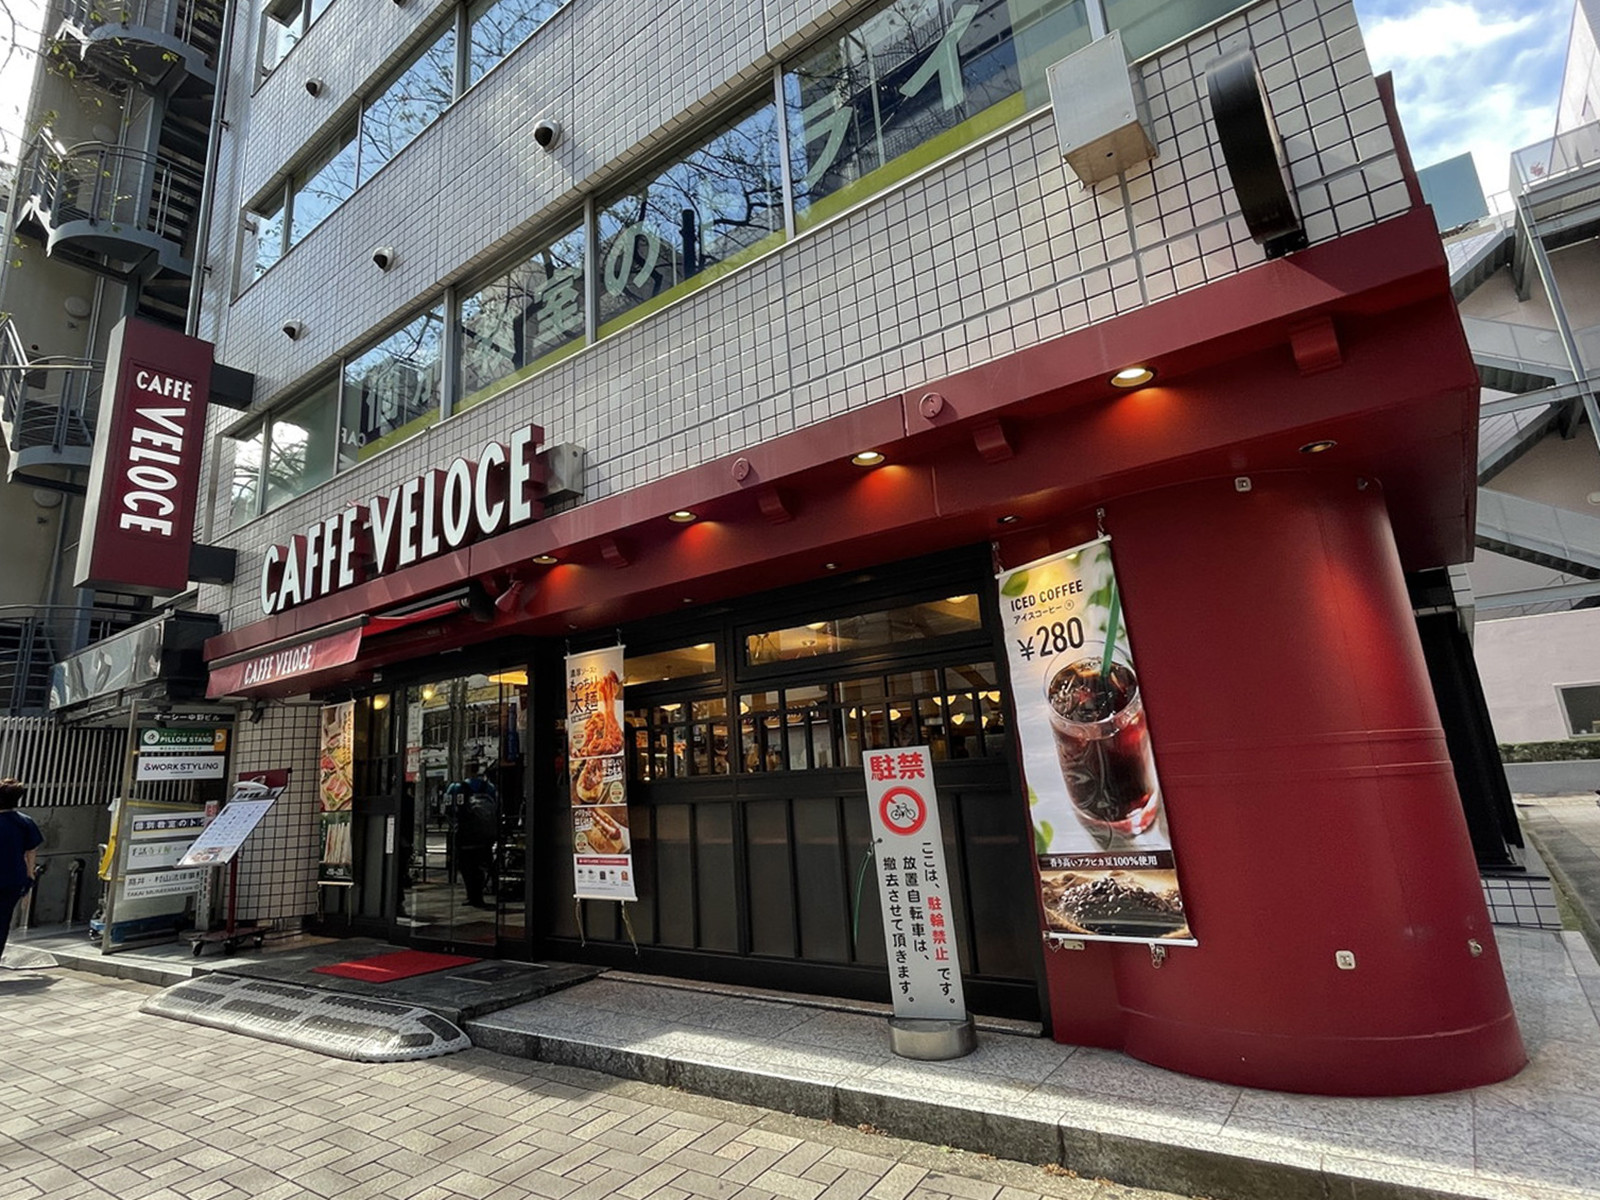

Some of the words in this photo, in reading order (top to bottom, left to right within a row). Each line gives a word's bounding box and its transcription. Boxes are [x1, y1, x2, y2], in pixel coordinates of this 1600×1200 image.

[119, 407, 187, 536] VELOCE
[370, 426, 533, 574] VELOCE
[1010, 594, 1036, 612] ICED
[1039, 579, 1084, 603] COFFEE
[1013, 605, 1063, 625] アイスコーヒー
[275, 644, 313, 676] VELOCE
[869, 751, 926, 781] 駐禁
[903, 856, 930, 961] 放置自転車は、
